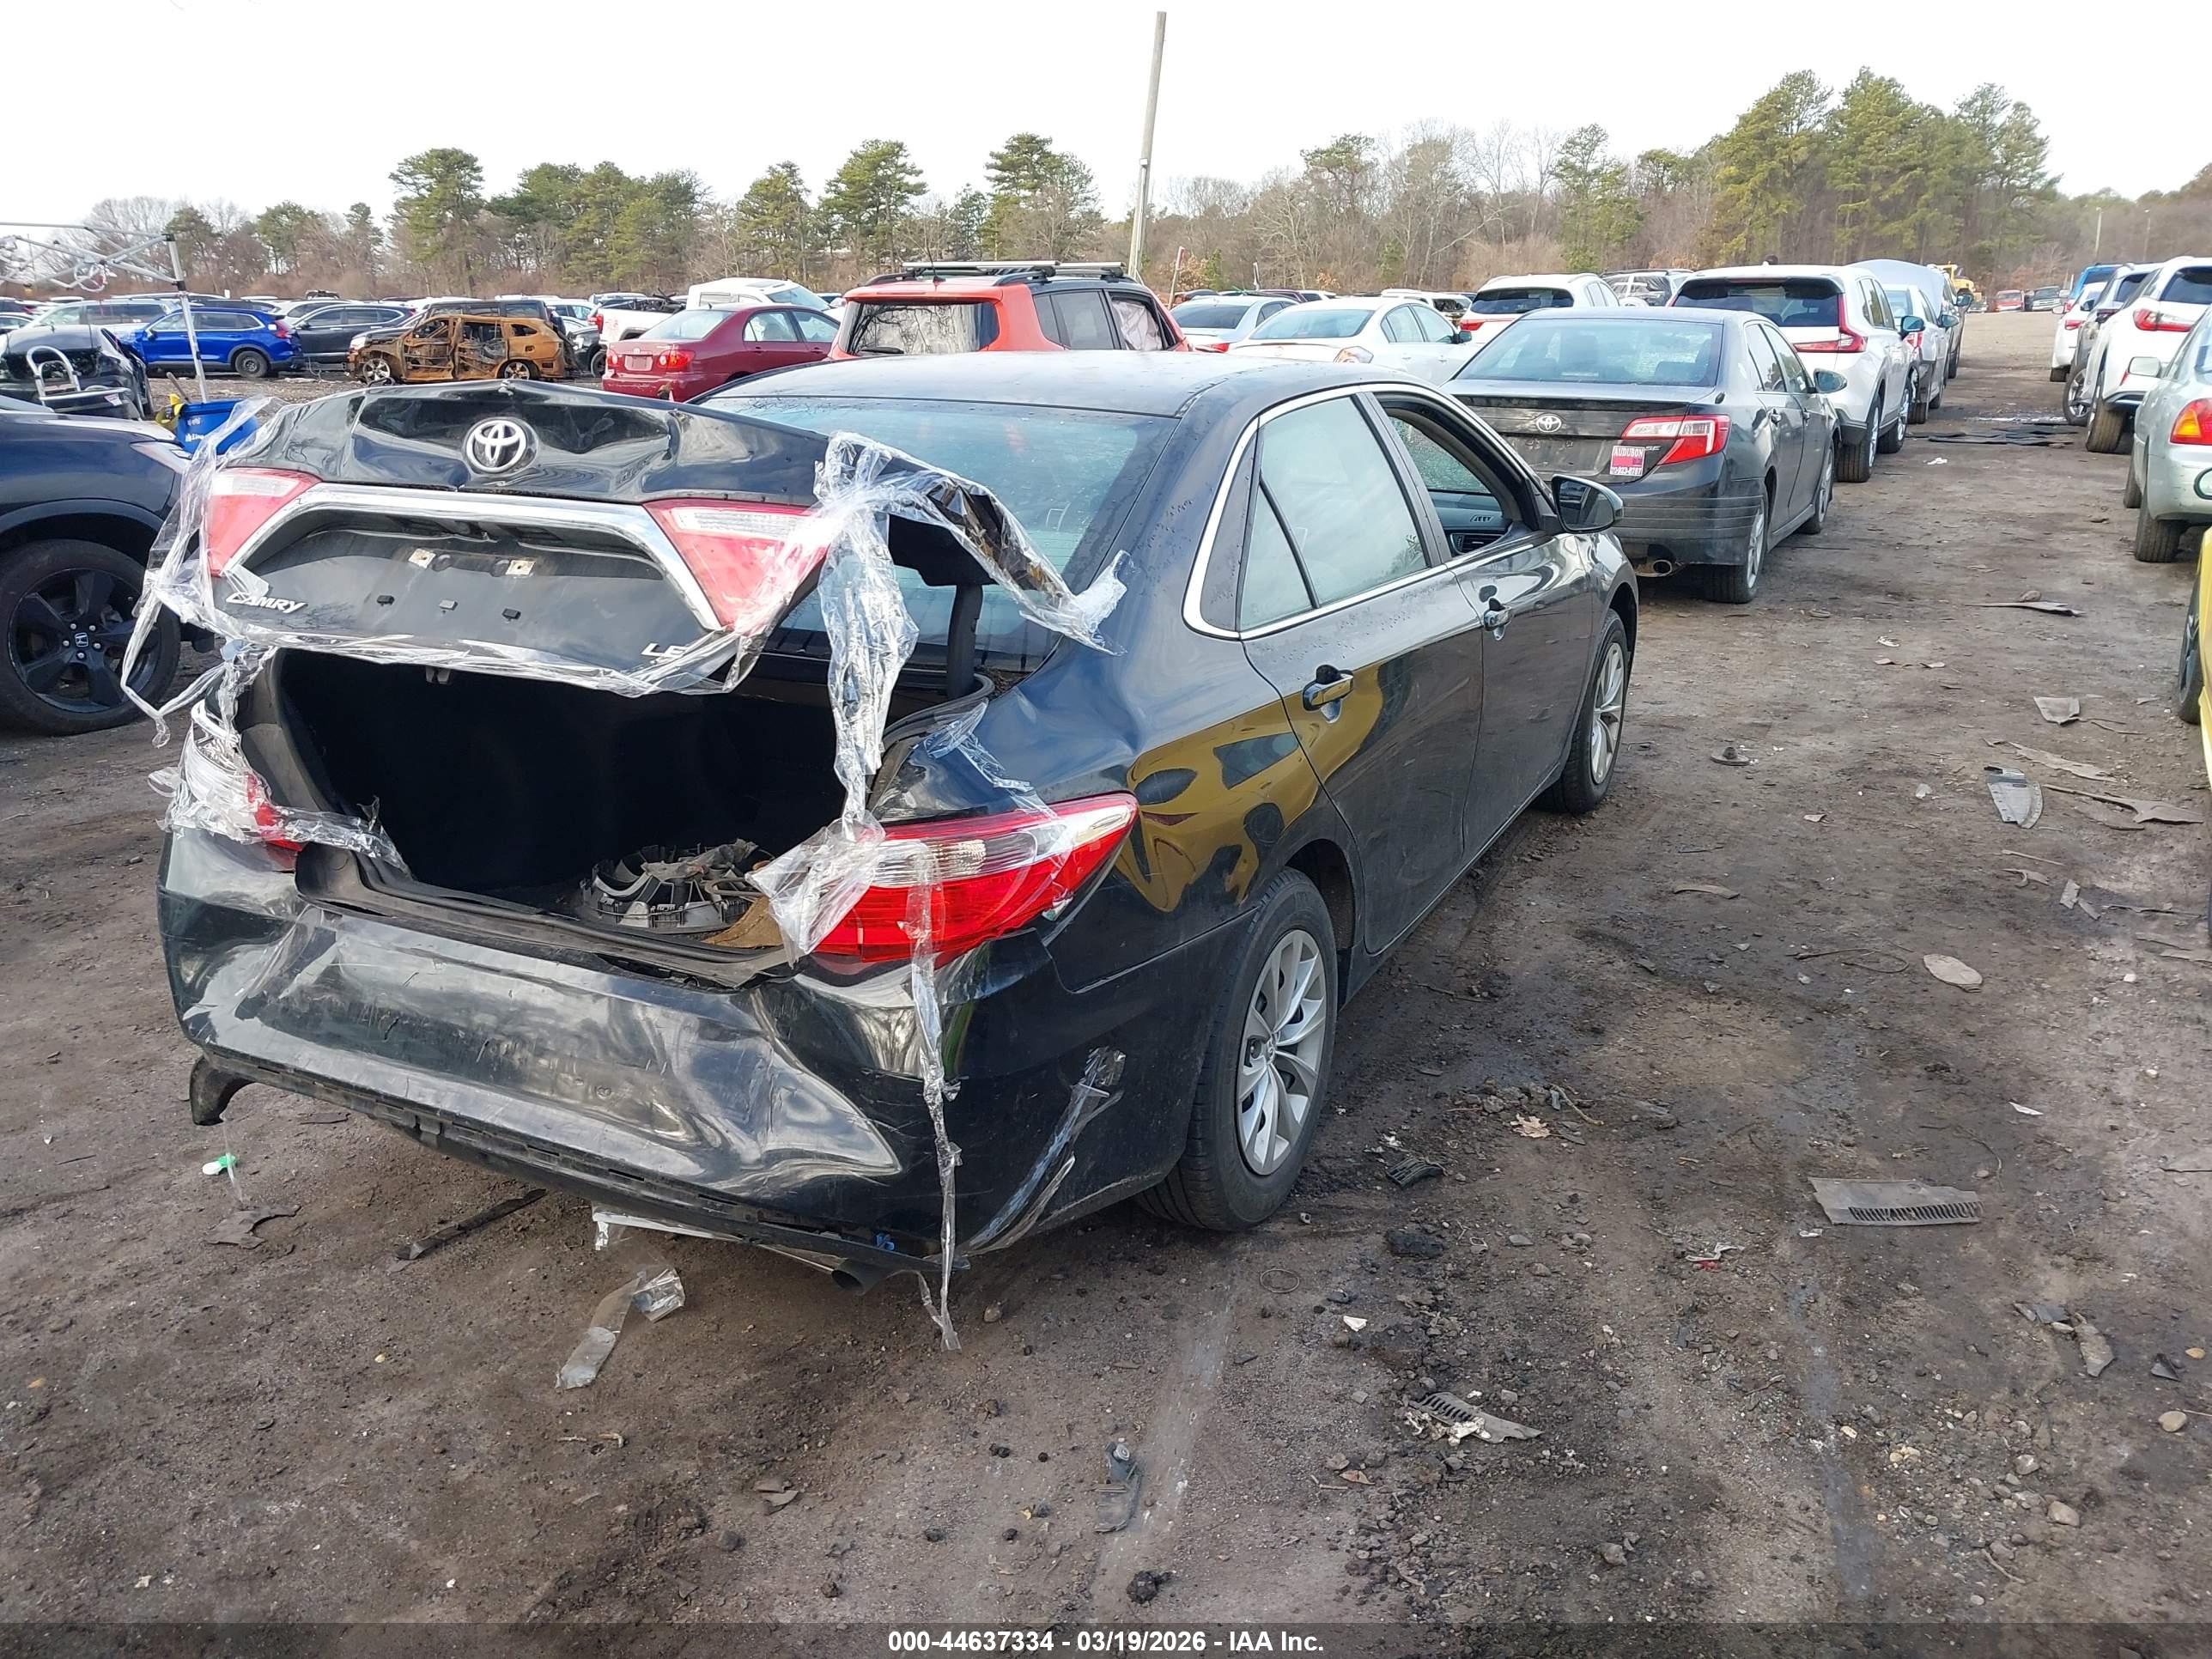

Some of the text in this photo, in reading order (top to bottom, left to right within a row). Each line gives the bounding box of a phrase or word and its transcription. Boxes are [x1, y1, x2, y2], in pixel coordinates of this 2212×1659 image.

[1613, 447, 1644, 457] AUDUBON
[226, 592, 307, 614] CAMRY
[641, 644, 690, 659] LE
